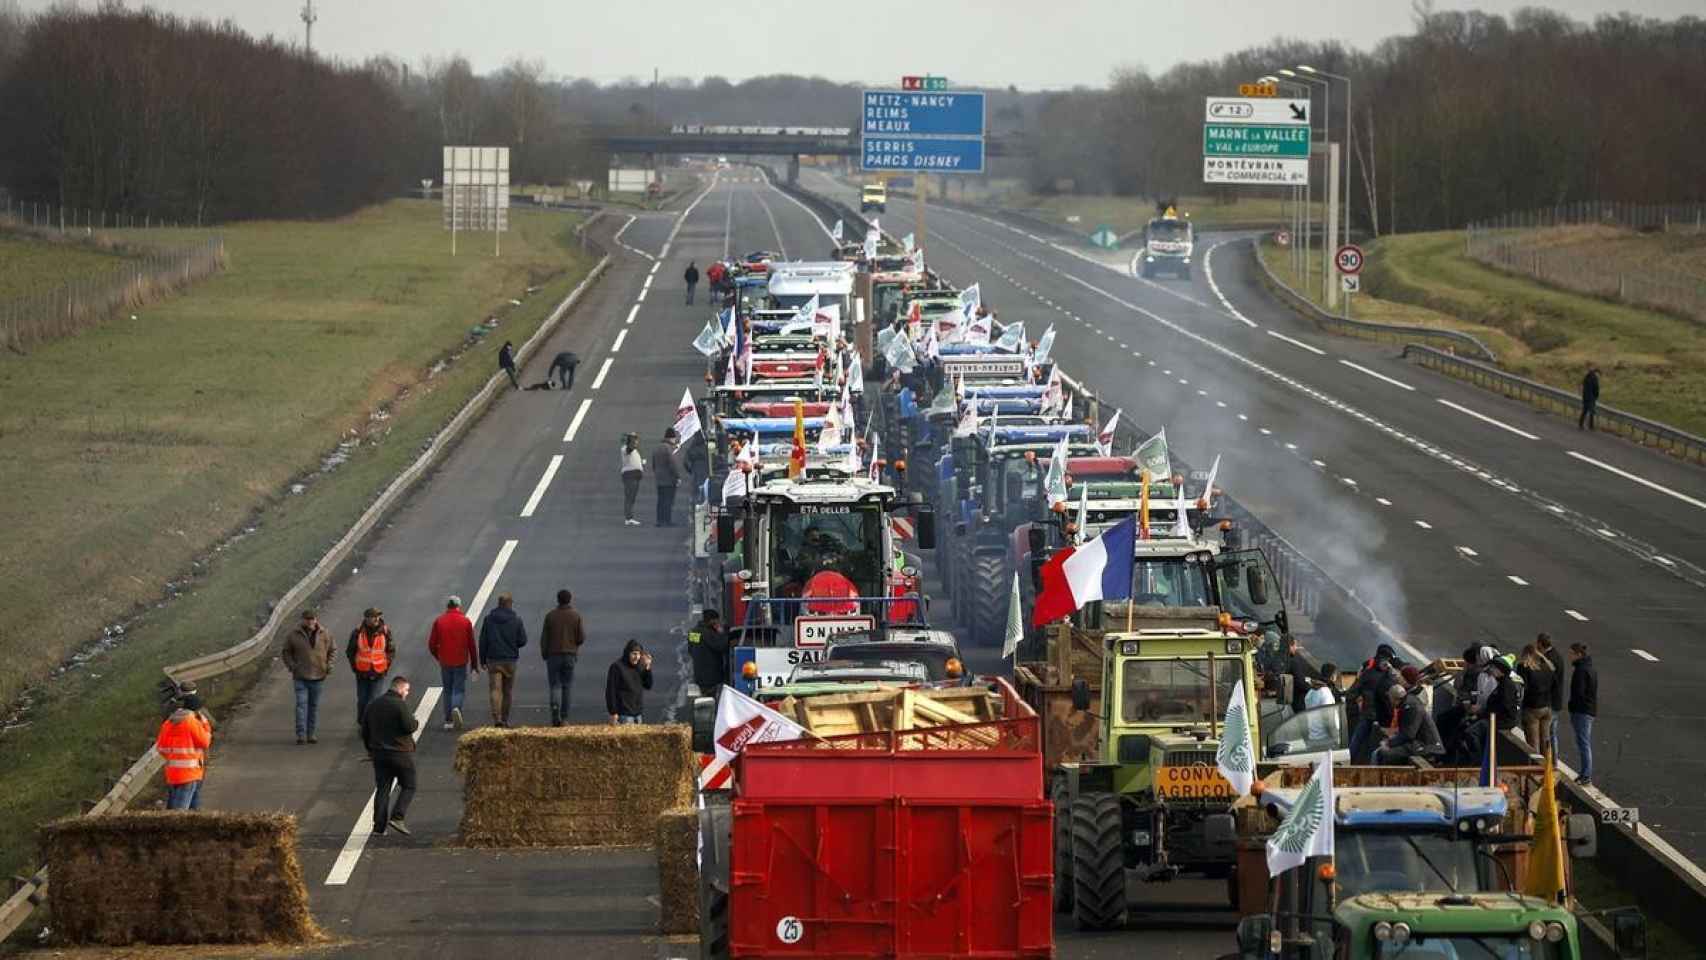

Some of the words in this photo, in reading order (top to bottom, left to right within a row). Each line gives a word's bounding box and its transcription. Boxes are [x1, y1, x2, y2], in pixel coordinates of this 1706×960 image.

[867, 108, 908, 119] REIMS
[867, 120, 911, 132] MEAUX
[1209, 128, 1248, 140] MARNE
[1264, 128, 1305, 142] VALLÉE
[867, 141, 915, 152] SERRIS
[1215, 142, 1232, 152] VAL
[867, 154, 909, 166] PARCS
[914, 155, 961, 167] DISNEY
[1208, 160, 1283, 170] MONTÉVRAIN
[1227, 171, 1286, 181] COMMERCIAL
[1341, 254, 1357, 266] 90
[800, 504, 818, 513] ETA
[1603, 810, 1630, 823] 28,2
[784, 919, 799, 939] 25
